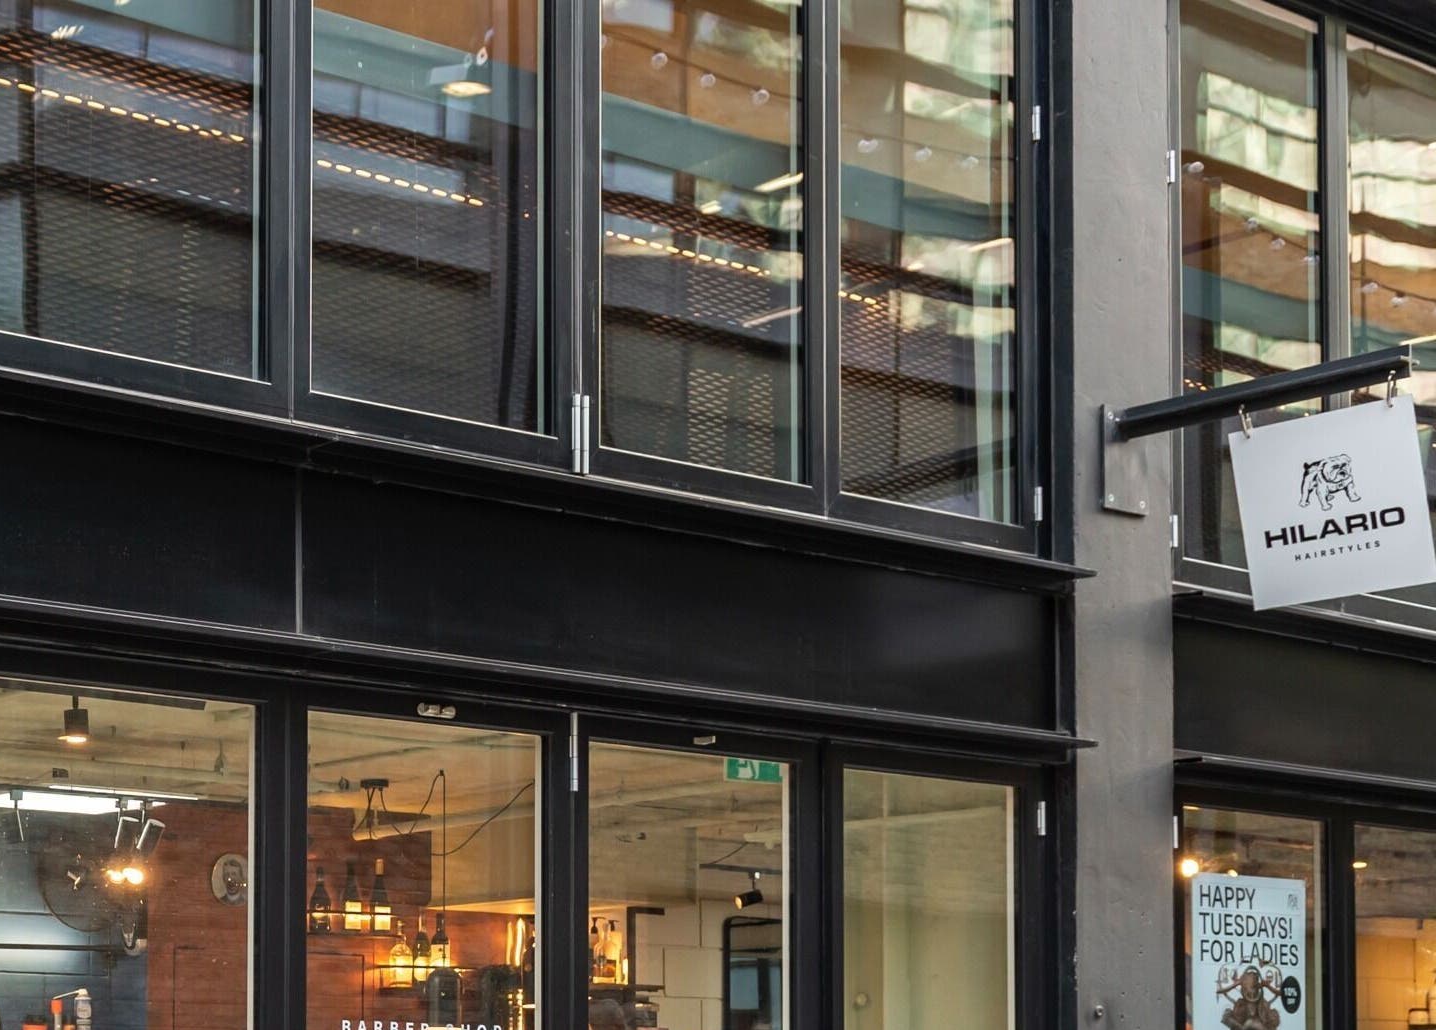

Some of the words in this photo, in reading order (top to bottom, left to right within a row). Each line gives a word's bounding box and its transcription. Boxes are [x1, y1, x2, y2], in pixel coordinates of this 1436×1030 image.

[1264, 506, 1405, 548] HILARIO
[1295, 540, 1381, 561] HAIRSTYLES
[1199, 884, 1256, 910] HAPPY
[1199, 912, 1293, 940] TUESDAYS!
[1200, 939, 1235, 963] FOR
[1240, 941, 1299, 967] LADIES
